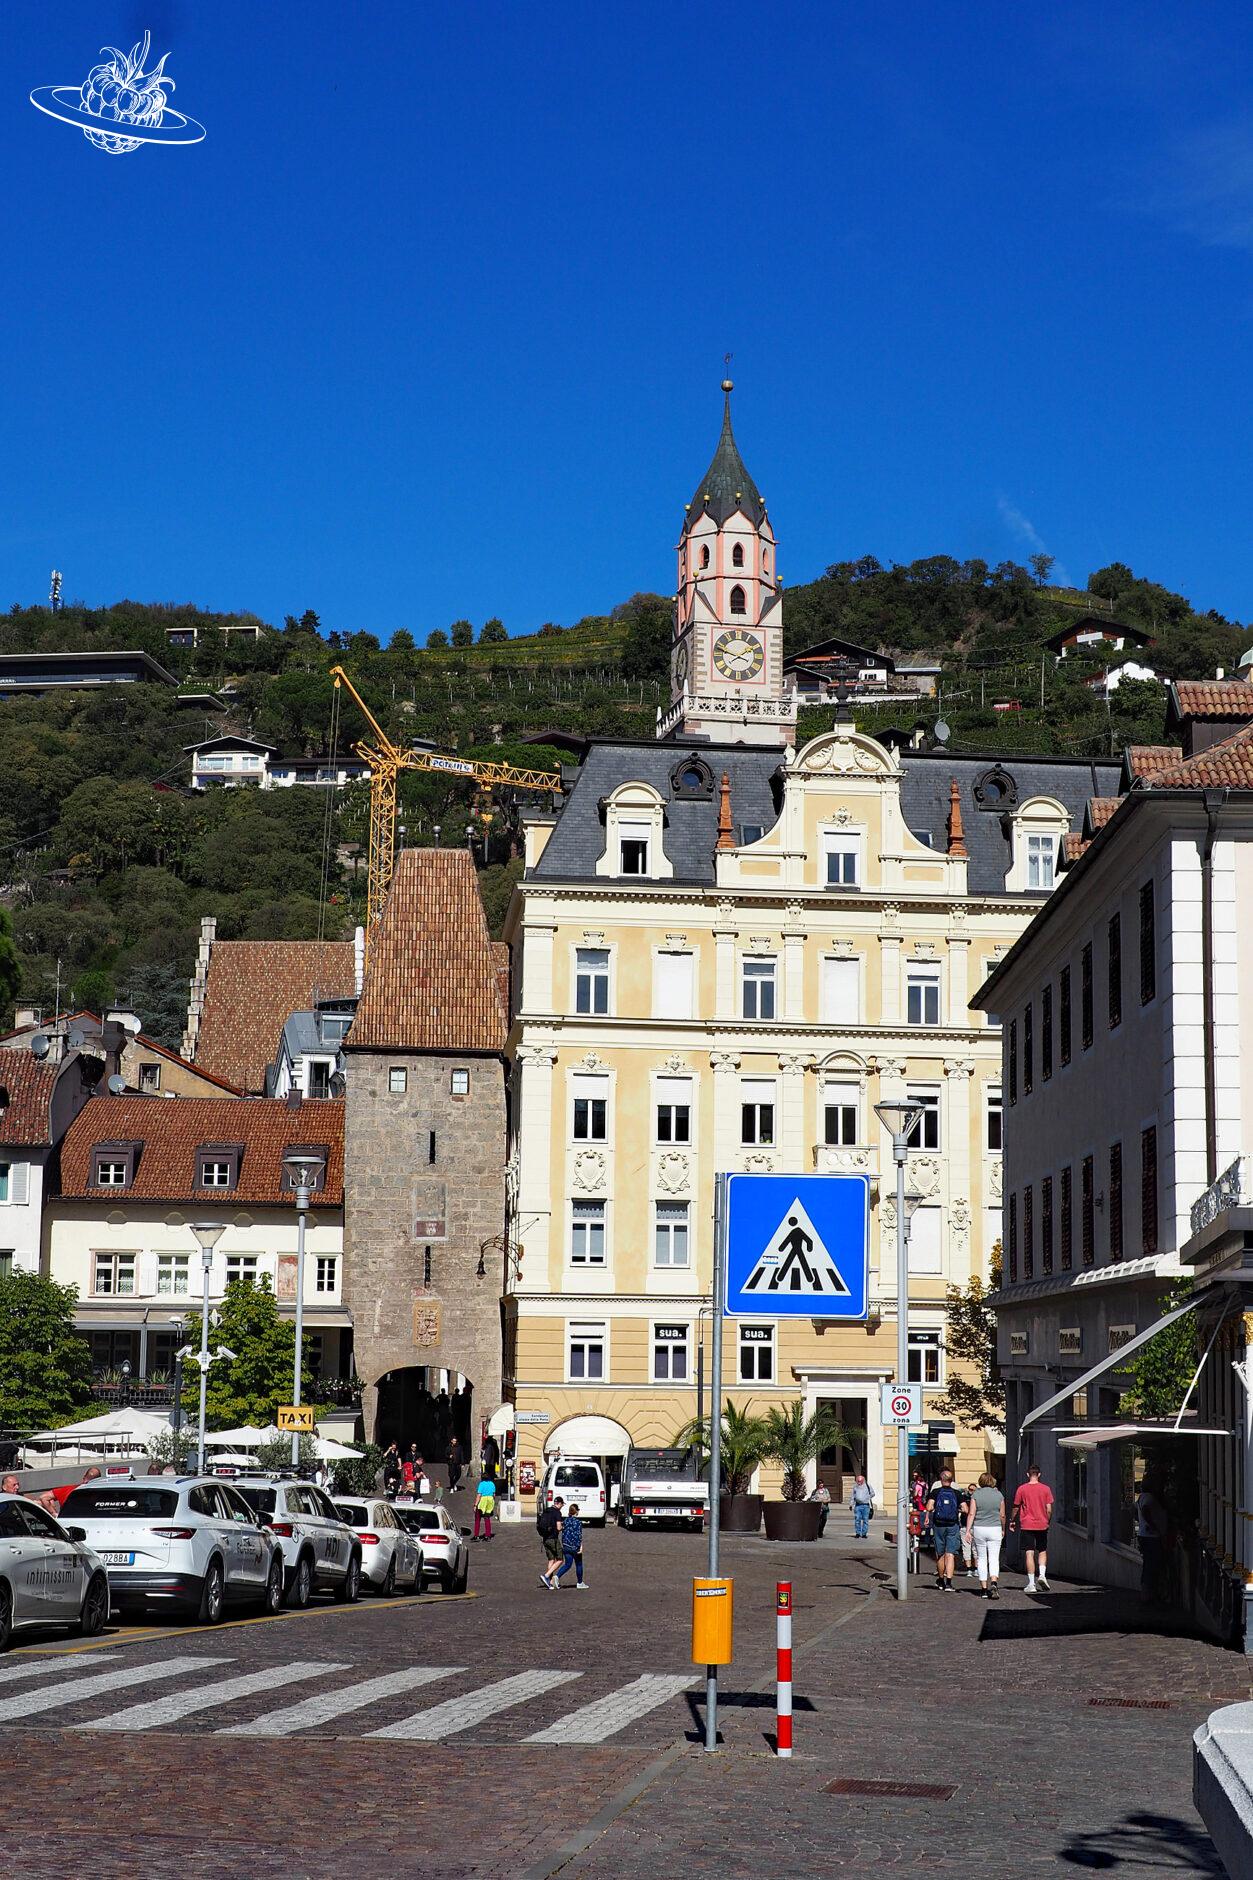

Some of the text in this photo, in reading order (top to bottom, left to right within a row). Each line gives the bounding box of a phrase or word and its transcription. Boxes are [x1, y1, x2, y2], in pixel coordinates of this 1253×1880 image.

[659, 1329, 683, 1338] sua.
[744, 1330, 768, 1339] sua.
[895, 1401, 908, 1411] 30
[279, 1413, 312, 1425] TAXI
[26, 1568, 76, 1585] intimissimi
